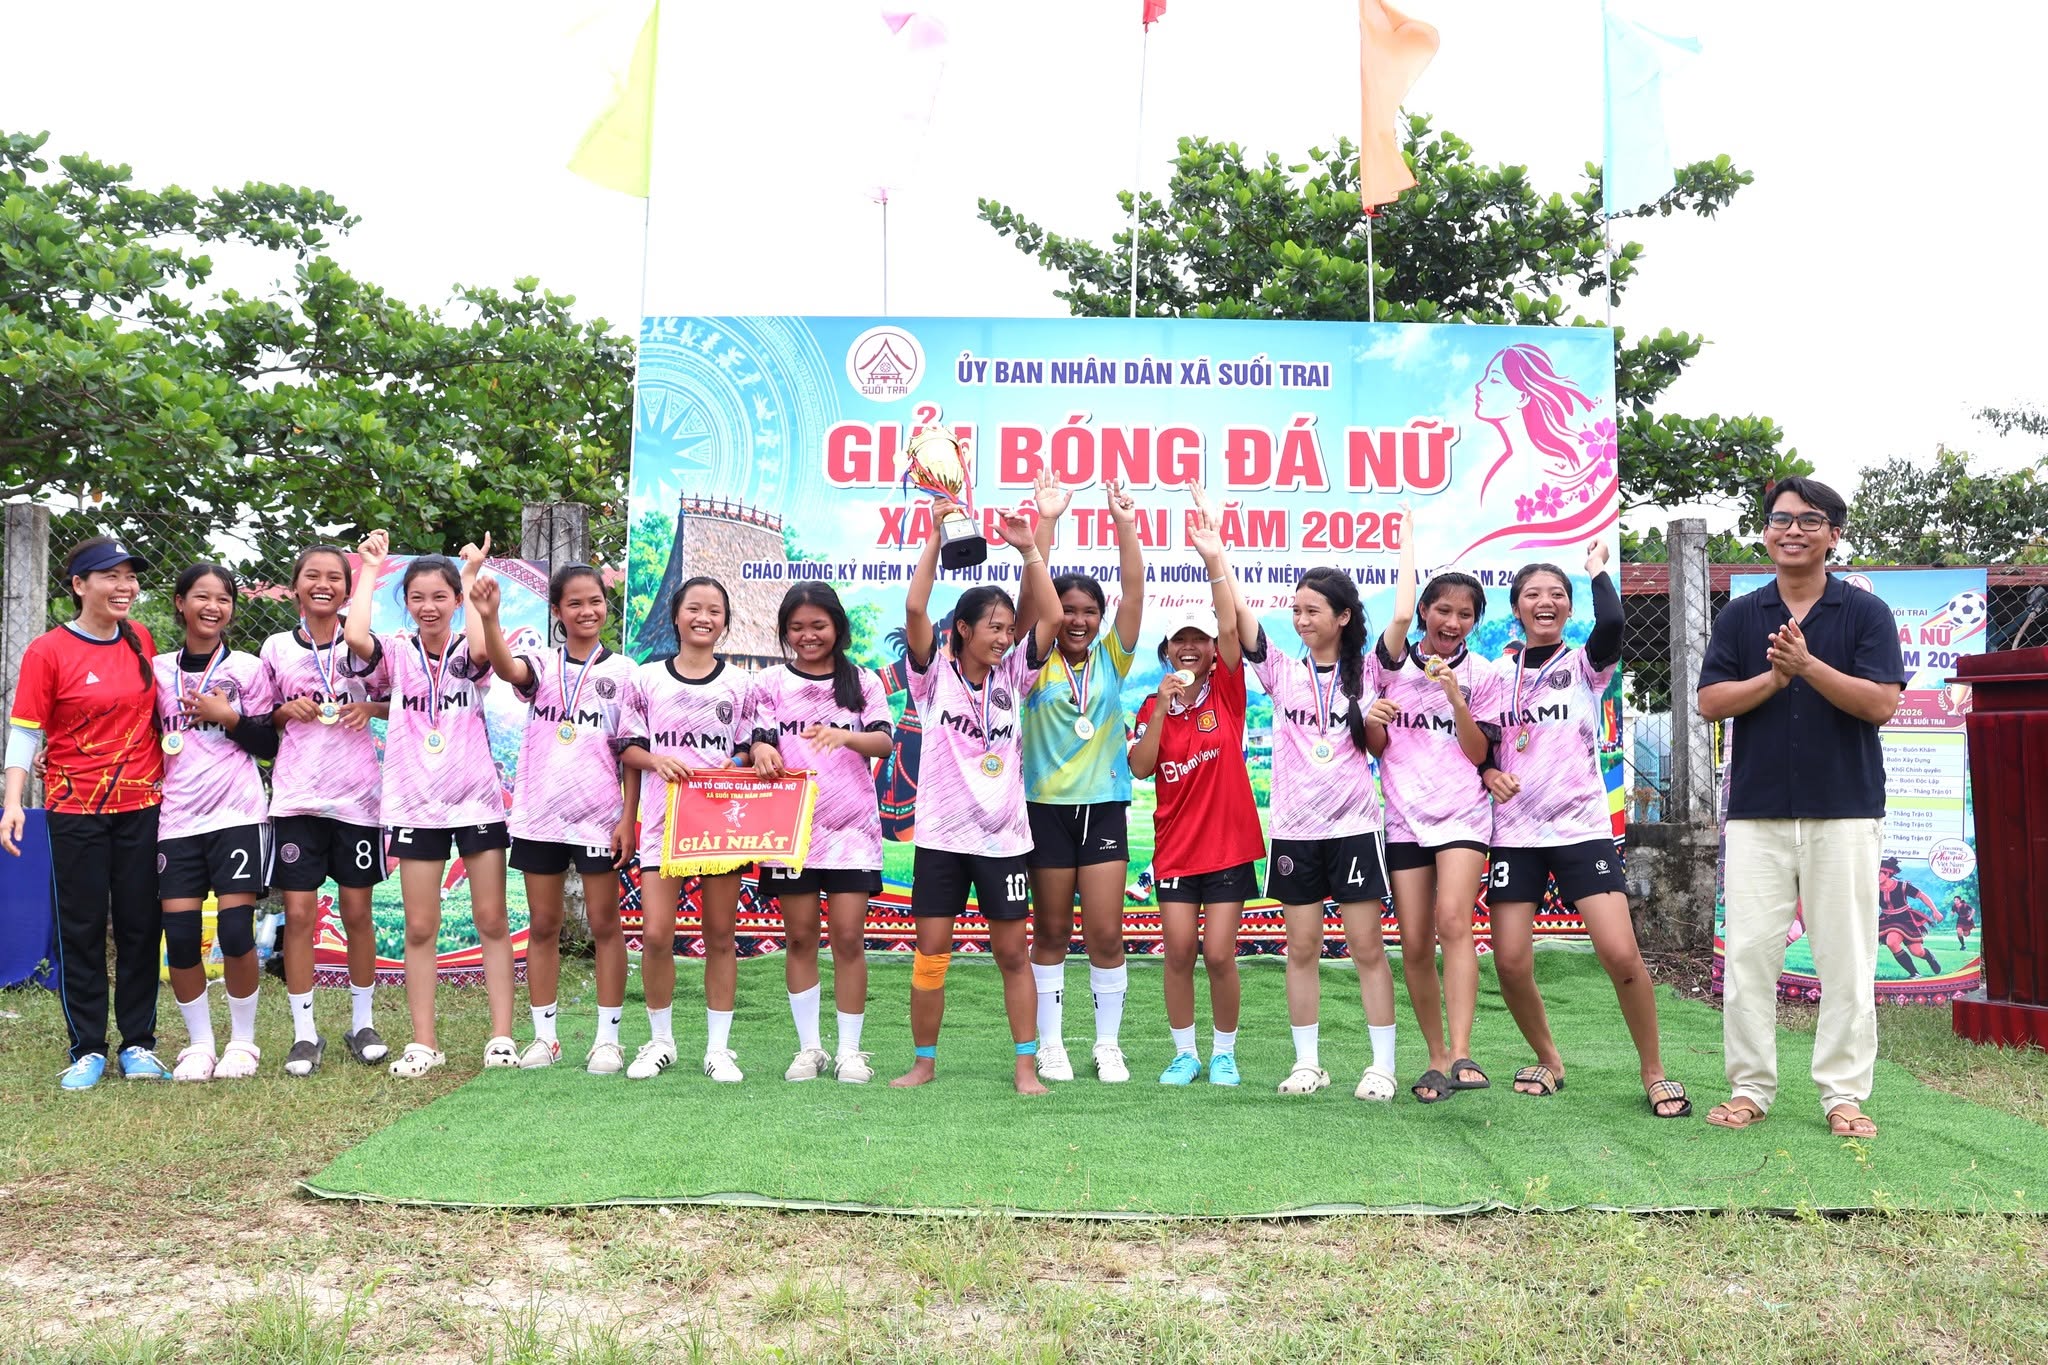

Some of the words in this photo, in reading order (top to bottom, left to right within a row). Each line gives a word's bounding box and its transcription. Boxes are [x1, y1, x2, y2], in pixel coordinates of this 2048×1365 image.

[957, 353, 988, 384] ỦY
[995, 361, 1043, 384] BAN
[1051, 357, 1116, 384] NHÂN
[1124, 357, 1172, 385] DÂN
[1180, 358, 1211, 385] XÃ
[1218, 356, 1272, 386] SUỐI
[1279, 364, 1330, 387] TRAI
[887, 386, 908, 395] TRAI
[827, 406, 973, 483] GII
[1000, 414, 1200, 485] BÓNG
[1224, 417, 1324, 486] ĐÁ
[1348, 420, 1454, 489] NỮ
[876, 499, 933, 545] XÃ
[1071, 508, 1167, 547] TRAI
[1302, 510, 1404, 550] 2026
[742, 559, 783, 580] CHÀO
[787, 559, 833, 580] MỪNG
[838, 558, 857, 580] KỶ
[862, 560, 901, 584] NIỆM
[952, 564, 983, 585] PHỤ
[987, 561, 1011, 581] NỮ
[1244, 561, 1263, 584] KỶ
[1268, 563, 1307, 587] NIỆM
[1356, 565, 1386, 585] VĂN
[1920, 624, 1954, 647] NỮ
[402, 691, 468, 713] MIMI
[654, 730, 727, 751] MIAMI
[355, 840, 373, 870] 8
[678, 830, 722, 852] GIẢI
[725, 829, 789, 850] NHẤT
[229, 848, 252, 880] 2
[1347, 856, 1365, 887] 4
[1005, 873, 1027, 902] 10
